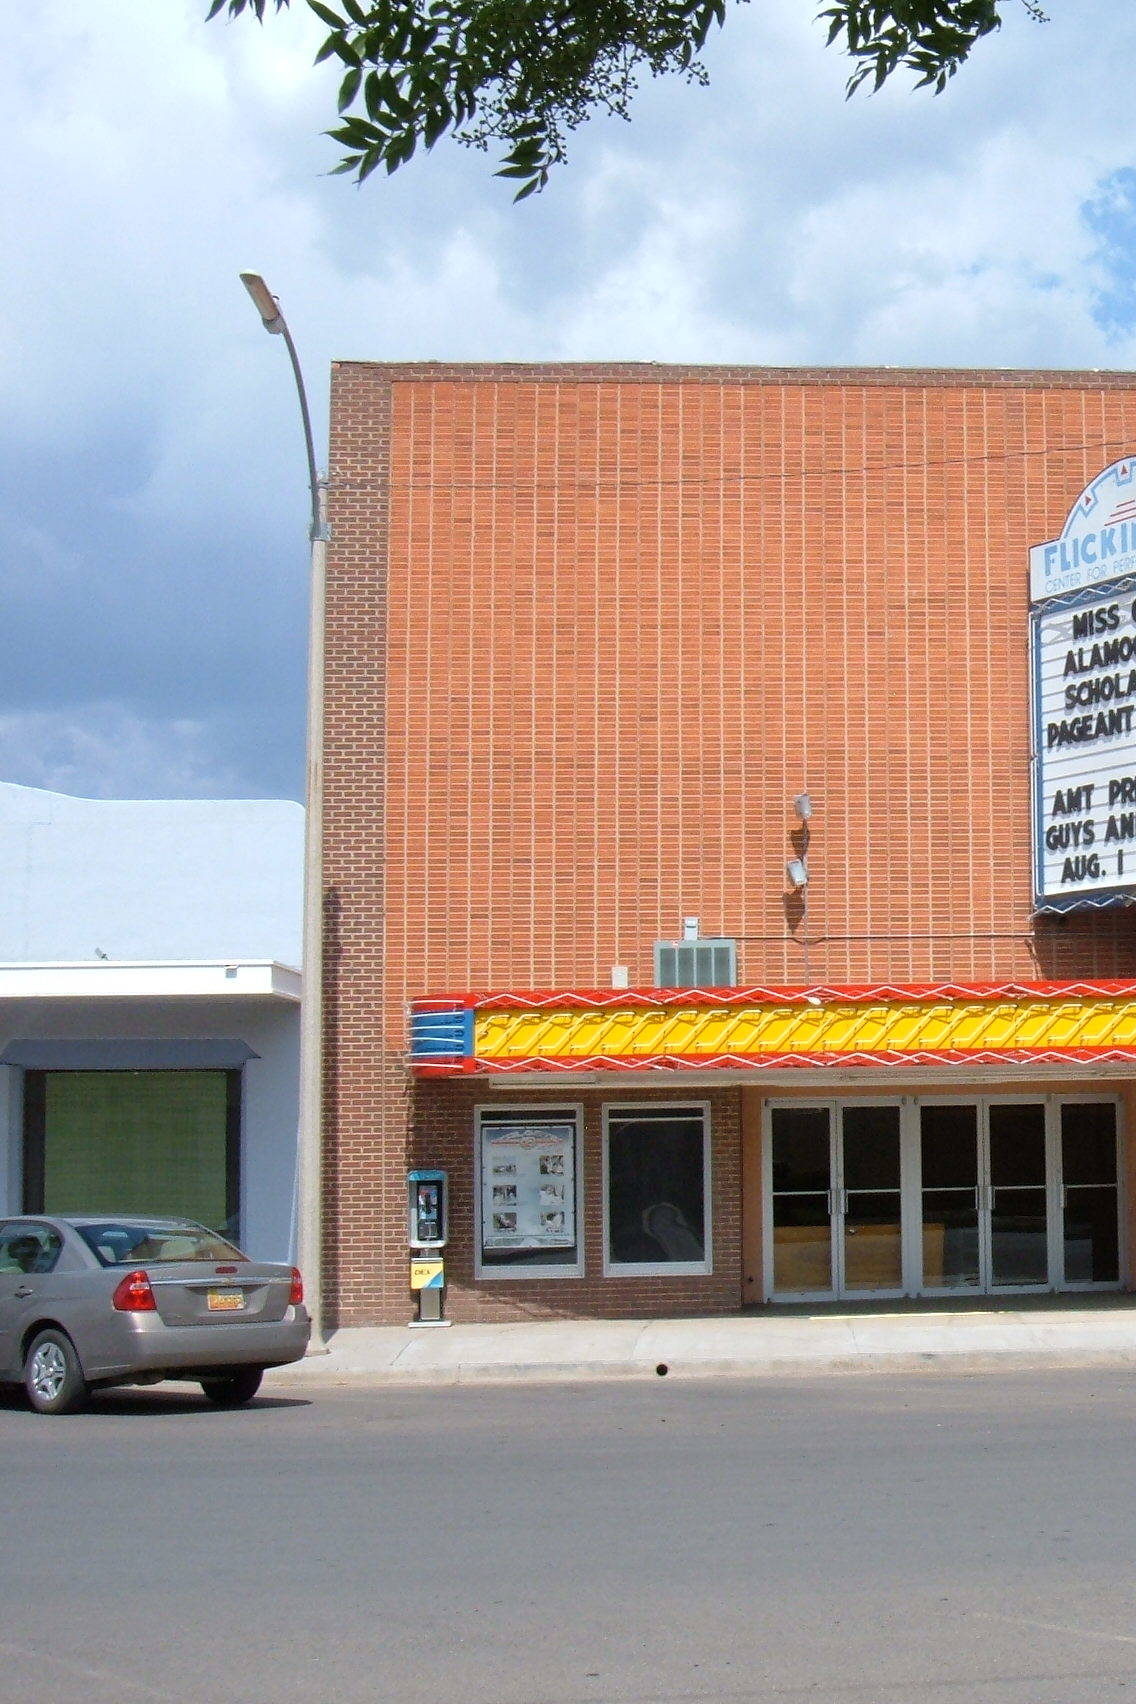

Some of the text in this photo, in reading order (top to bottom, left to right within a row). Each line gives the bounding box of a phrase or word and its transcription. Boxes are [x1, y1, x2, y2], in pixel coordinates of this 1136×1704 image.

[1046, 572, 1081, 594] CENTER
[1088, 564, 1107, 580] FOR
[1073, 604, 1120, 639] MISS
[1047, 705, 1135, 748] PAGEANT
[1052, 784, 1095, 816] AMT
[1046, 819, 1095, 850] GUYS
[1061, 853, 1106, 883] AUG.
[1117, 849, 1124, 875] 1
